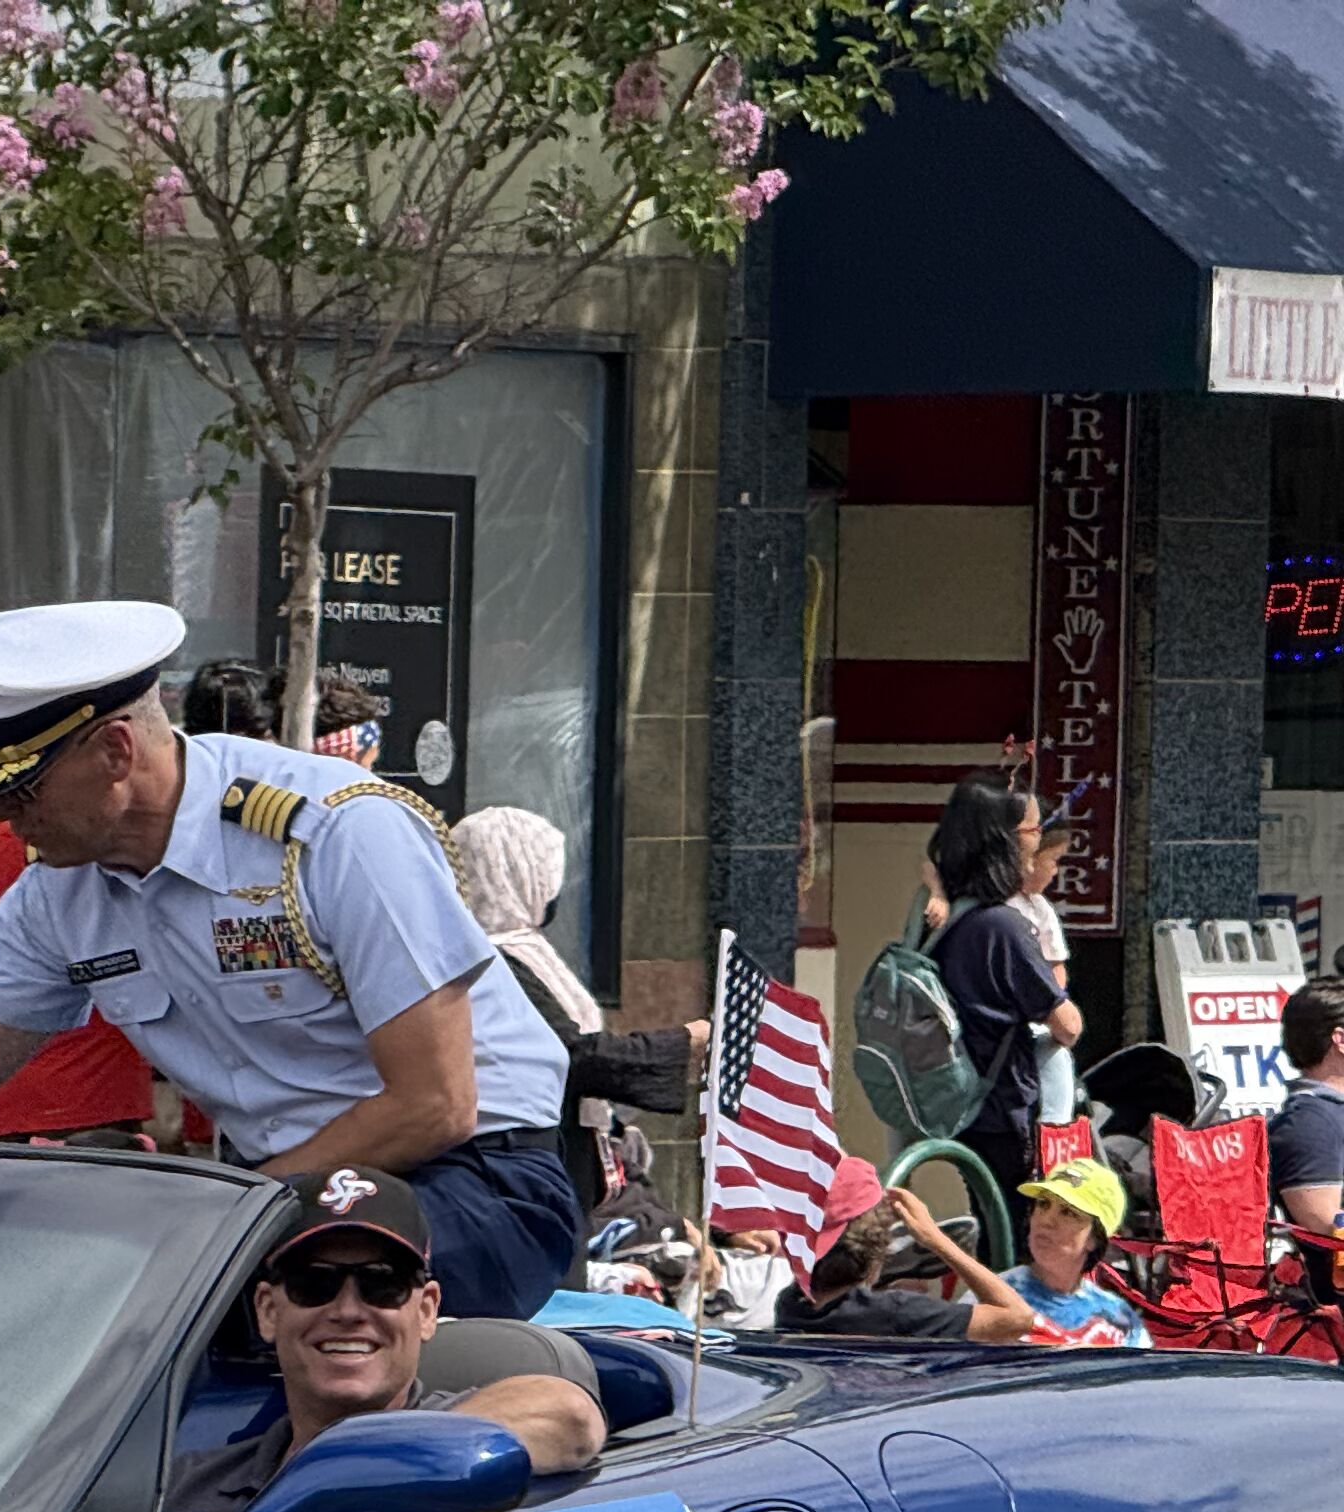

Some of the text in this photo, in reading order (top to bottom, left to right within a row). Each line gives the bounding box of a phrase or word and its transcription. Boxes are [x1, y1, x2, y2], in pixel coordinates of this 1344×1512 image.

[334, 552, 402, 586] LEASE
[404, 605, 443, 625] SPACE
[1194, 995, 1279, 1023] OPEN
[319, 1169, 378, 1215] SF
